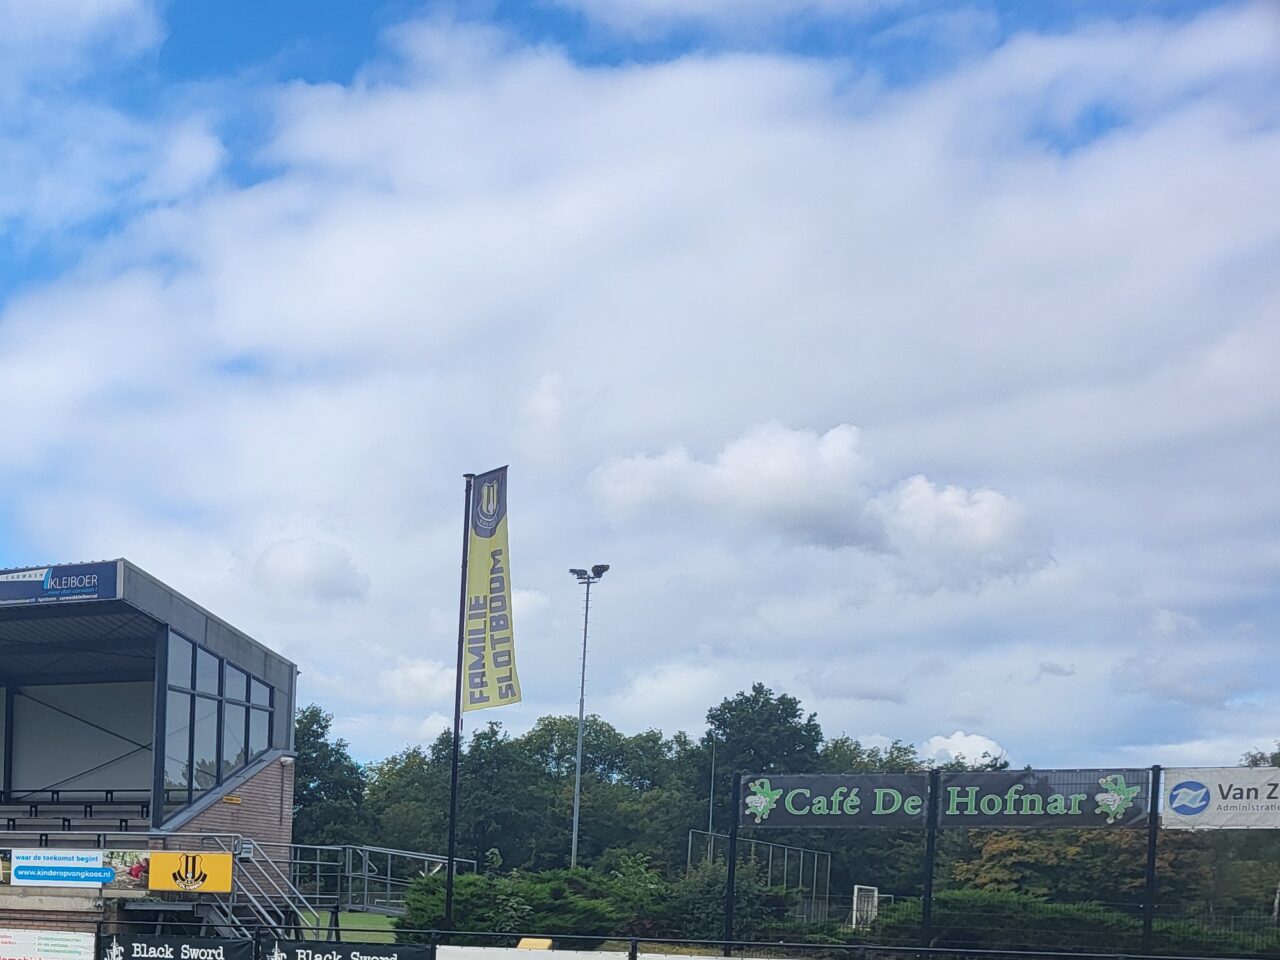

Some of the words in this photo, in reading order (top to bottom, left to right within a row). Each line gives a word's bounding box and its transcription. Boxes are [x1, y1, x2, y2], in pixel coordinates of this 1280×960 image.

[49, 575, 98, 589] KLEIBOER
[489, 548, 516, 700] SLOTBOOM
[468, 595, 490, 705] FAMILIE
[785, 786, 861, 815] Café
[872, 788, 923, 815] De
[946, 784, 1087, 815] Hofnar
[1217, 784, 1259, 800] Van
[15, 854, 31, 862] waar
[43, 854, 74, 863] toekomst
[76, 854, 98, 864] begint
[18, 868, 111, 879] www.kinderopvangkoos.nl
[131, 943, 174, 959] Black
[181, 944, 225, 960] Sword
